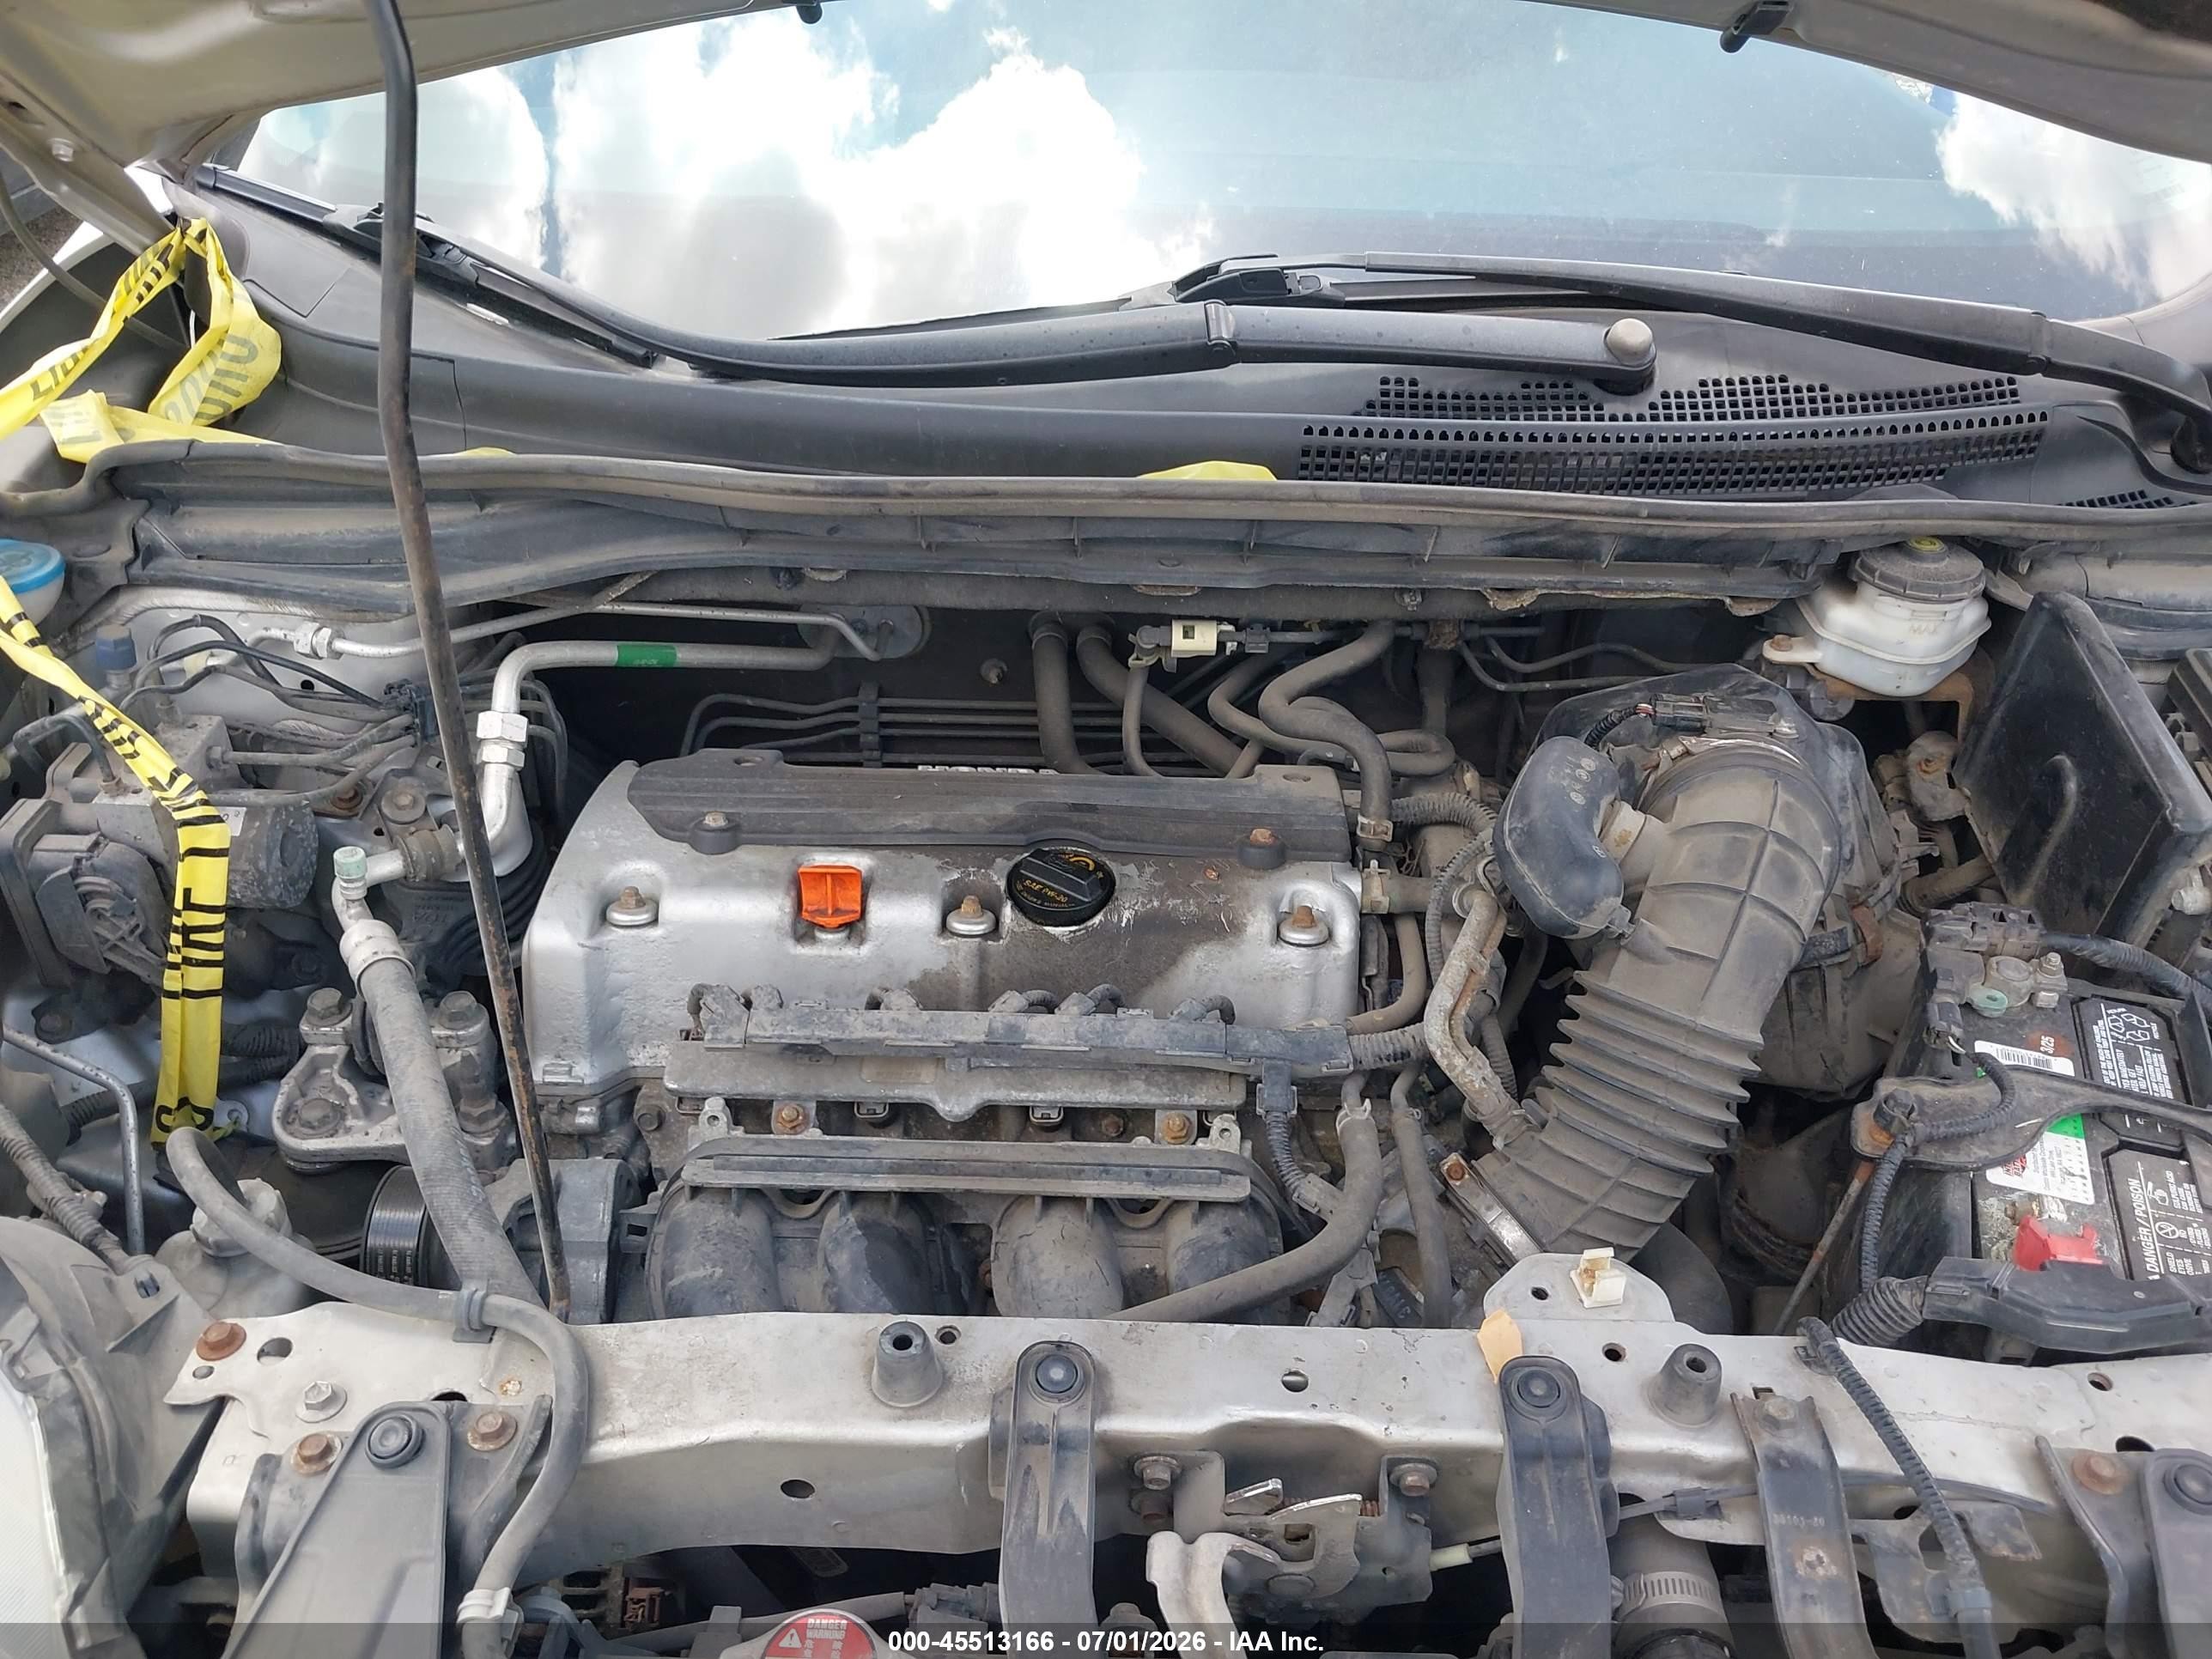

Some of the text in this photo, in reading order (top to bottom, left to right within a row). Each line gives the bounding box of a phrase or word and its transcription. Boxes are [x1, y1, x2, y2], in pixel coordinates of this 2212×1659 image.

[1024, 879, 1043, 891] SAE
[2040, 1035, 2055, 1054] 3/25
[2176, 1259, 2186, 1275] EYES
[807, 1618, 848, 1630] DANGER
[806, 1628, 846, 1640] WARNING
